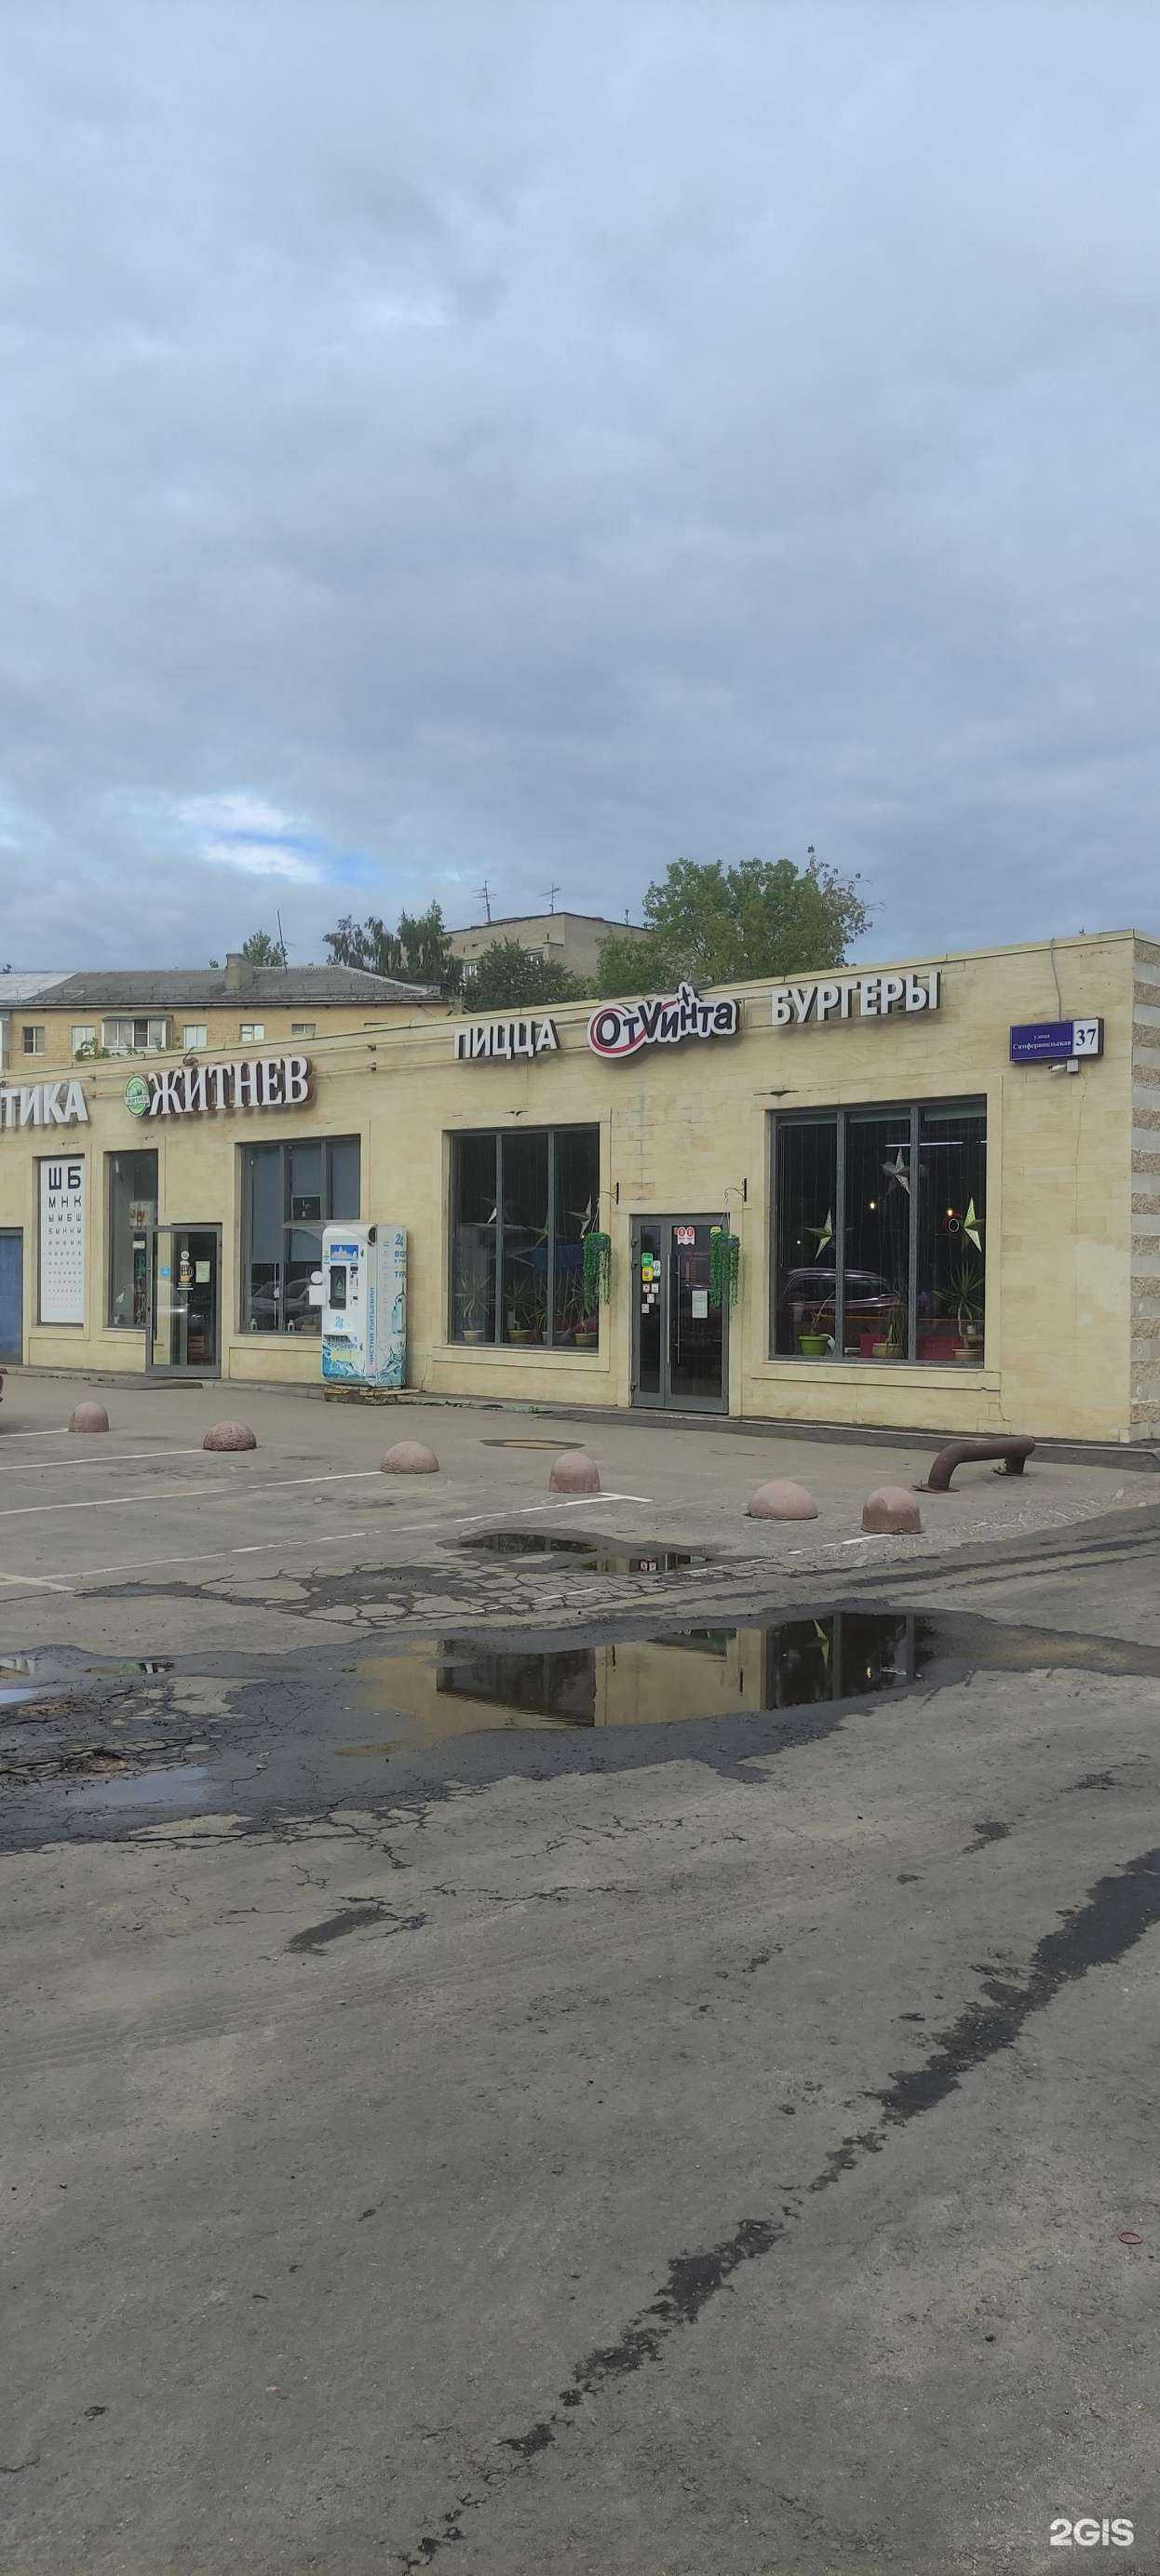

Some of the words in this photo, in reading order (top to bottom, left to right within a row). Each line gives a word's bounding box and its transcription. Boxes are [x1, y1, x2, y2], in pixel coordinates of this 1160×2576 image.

[771, 972, 939, 1026] БУРГЕРЫ
[453, 1019, 559, 1060] ПИЦЦА
[1075, 1028, 1097, 1047] 37
[148, 1056, 310, 1116] ЖИТНЕВ
[48, 1166, 62, 1190] Ш
[67, 1165, 81, 1189] Б
